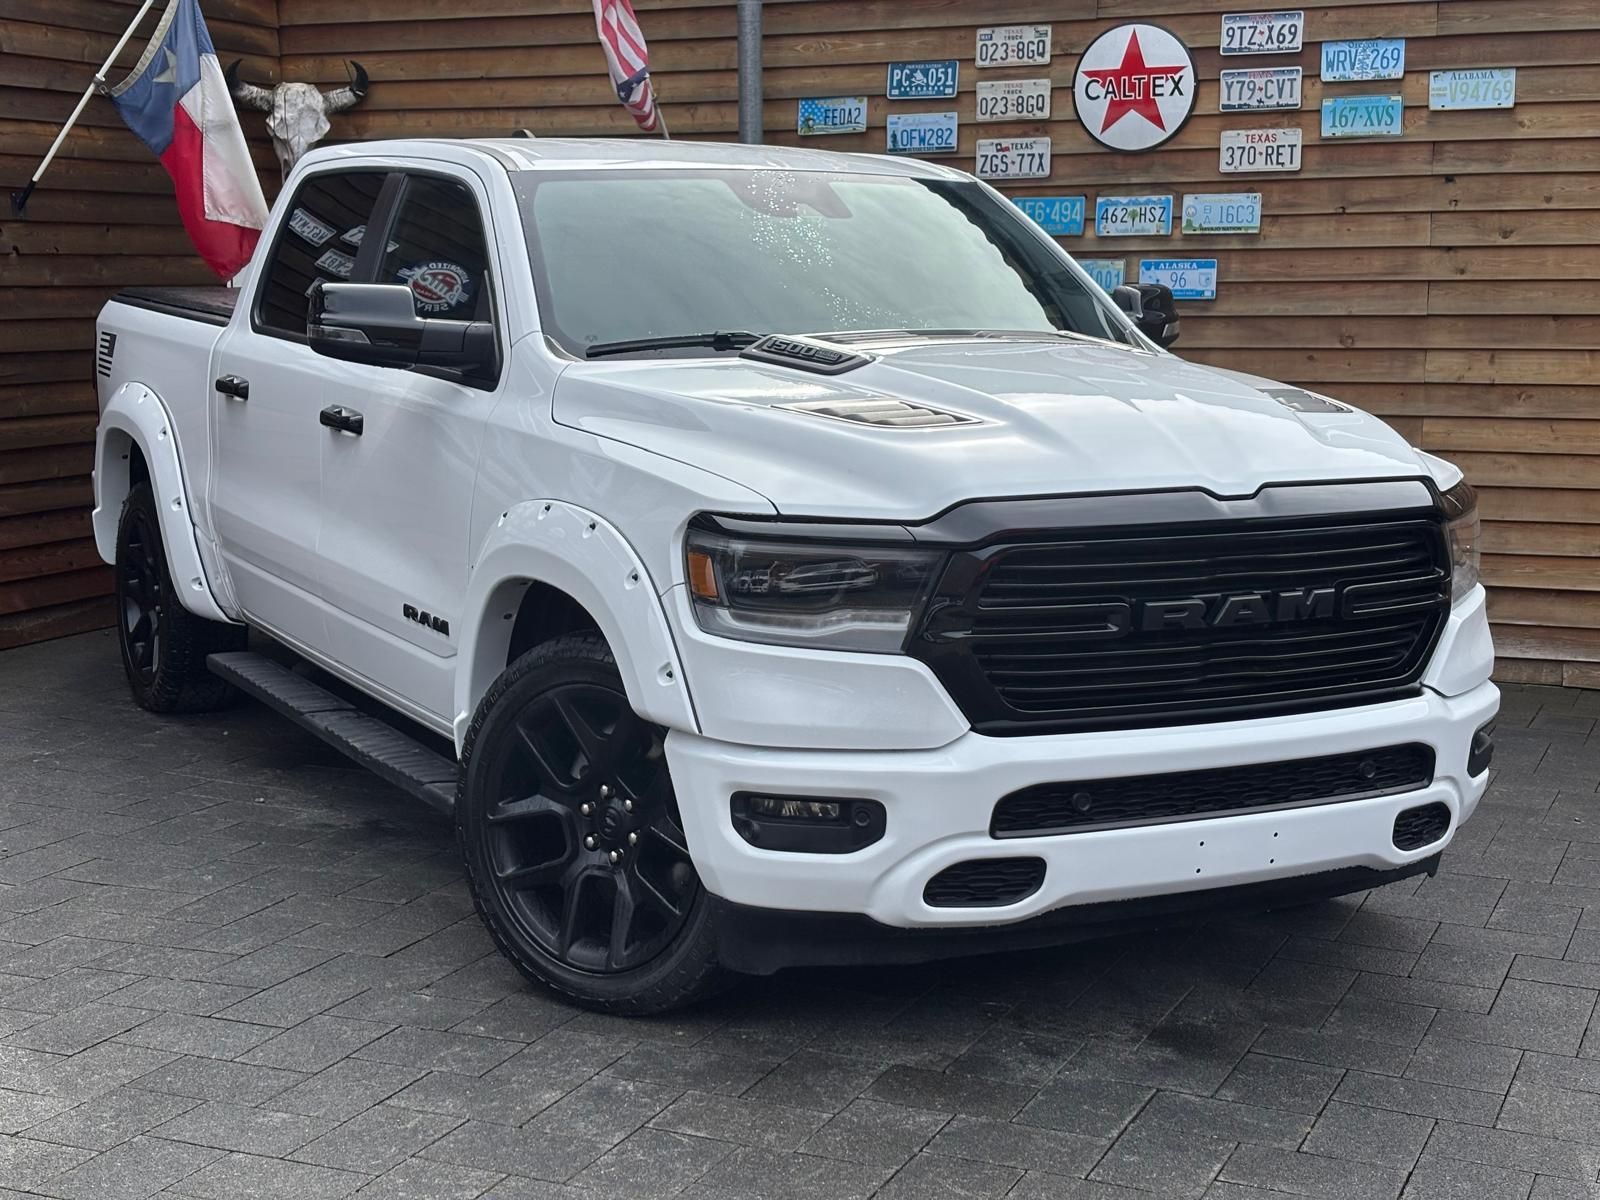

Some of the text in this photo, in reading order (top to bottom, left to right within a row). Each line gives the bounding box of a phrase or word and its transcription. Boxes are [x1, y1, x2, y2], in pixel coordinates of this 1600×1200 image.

[1226, 24, 1298, 46] 9TZ X69
[980, 39, 1046, 62] 023 8GQ
[1325, 47, 1401, 73] WRV 269
[892, 68, 954, 87] PC 051
[1450, 70, 1495, 80] ALABAMA
[1084, 74, 1184, 101] CALTEX
[1225, 77, 1297, 102] Y79 CVT
[1448, 79, 1514, 103] V94769
[980, 93, 1045, 116] 023 8GQ
[1010, 142, 1034, 151] TEXAS
[1245, 133, 1278, 144] TEXAS
[979, 152, 1045, 174] ZGS 77X
[1225, 144, 1297, 167] 370 RET
[1100, 206, 1167, 224] 462 HSZ
[1158, 262, 1199, 270] ALASKA
[1170, 271, 1187, 288] 96
[766, 337, 820, 358] 1500
[402, 603, 450, 637] RAM
[1142, 587, 1335, 631] RAM
